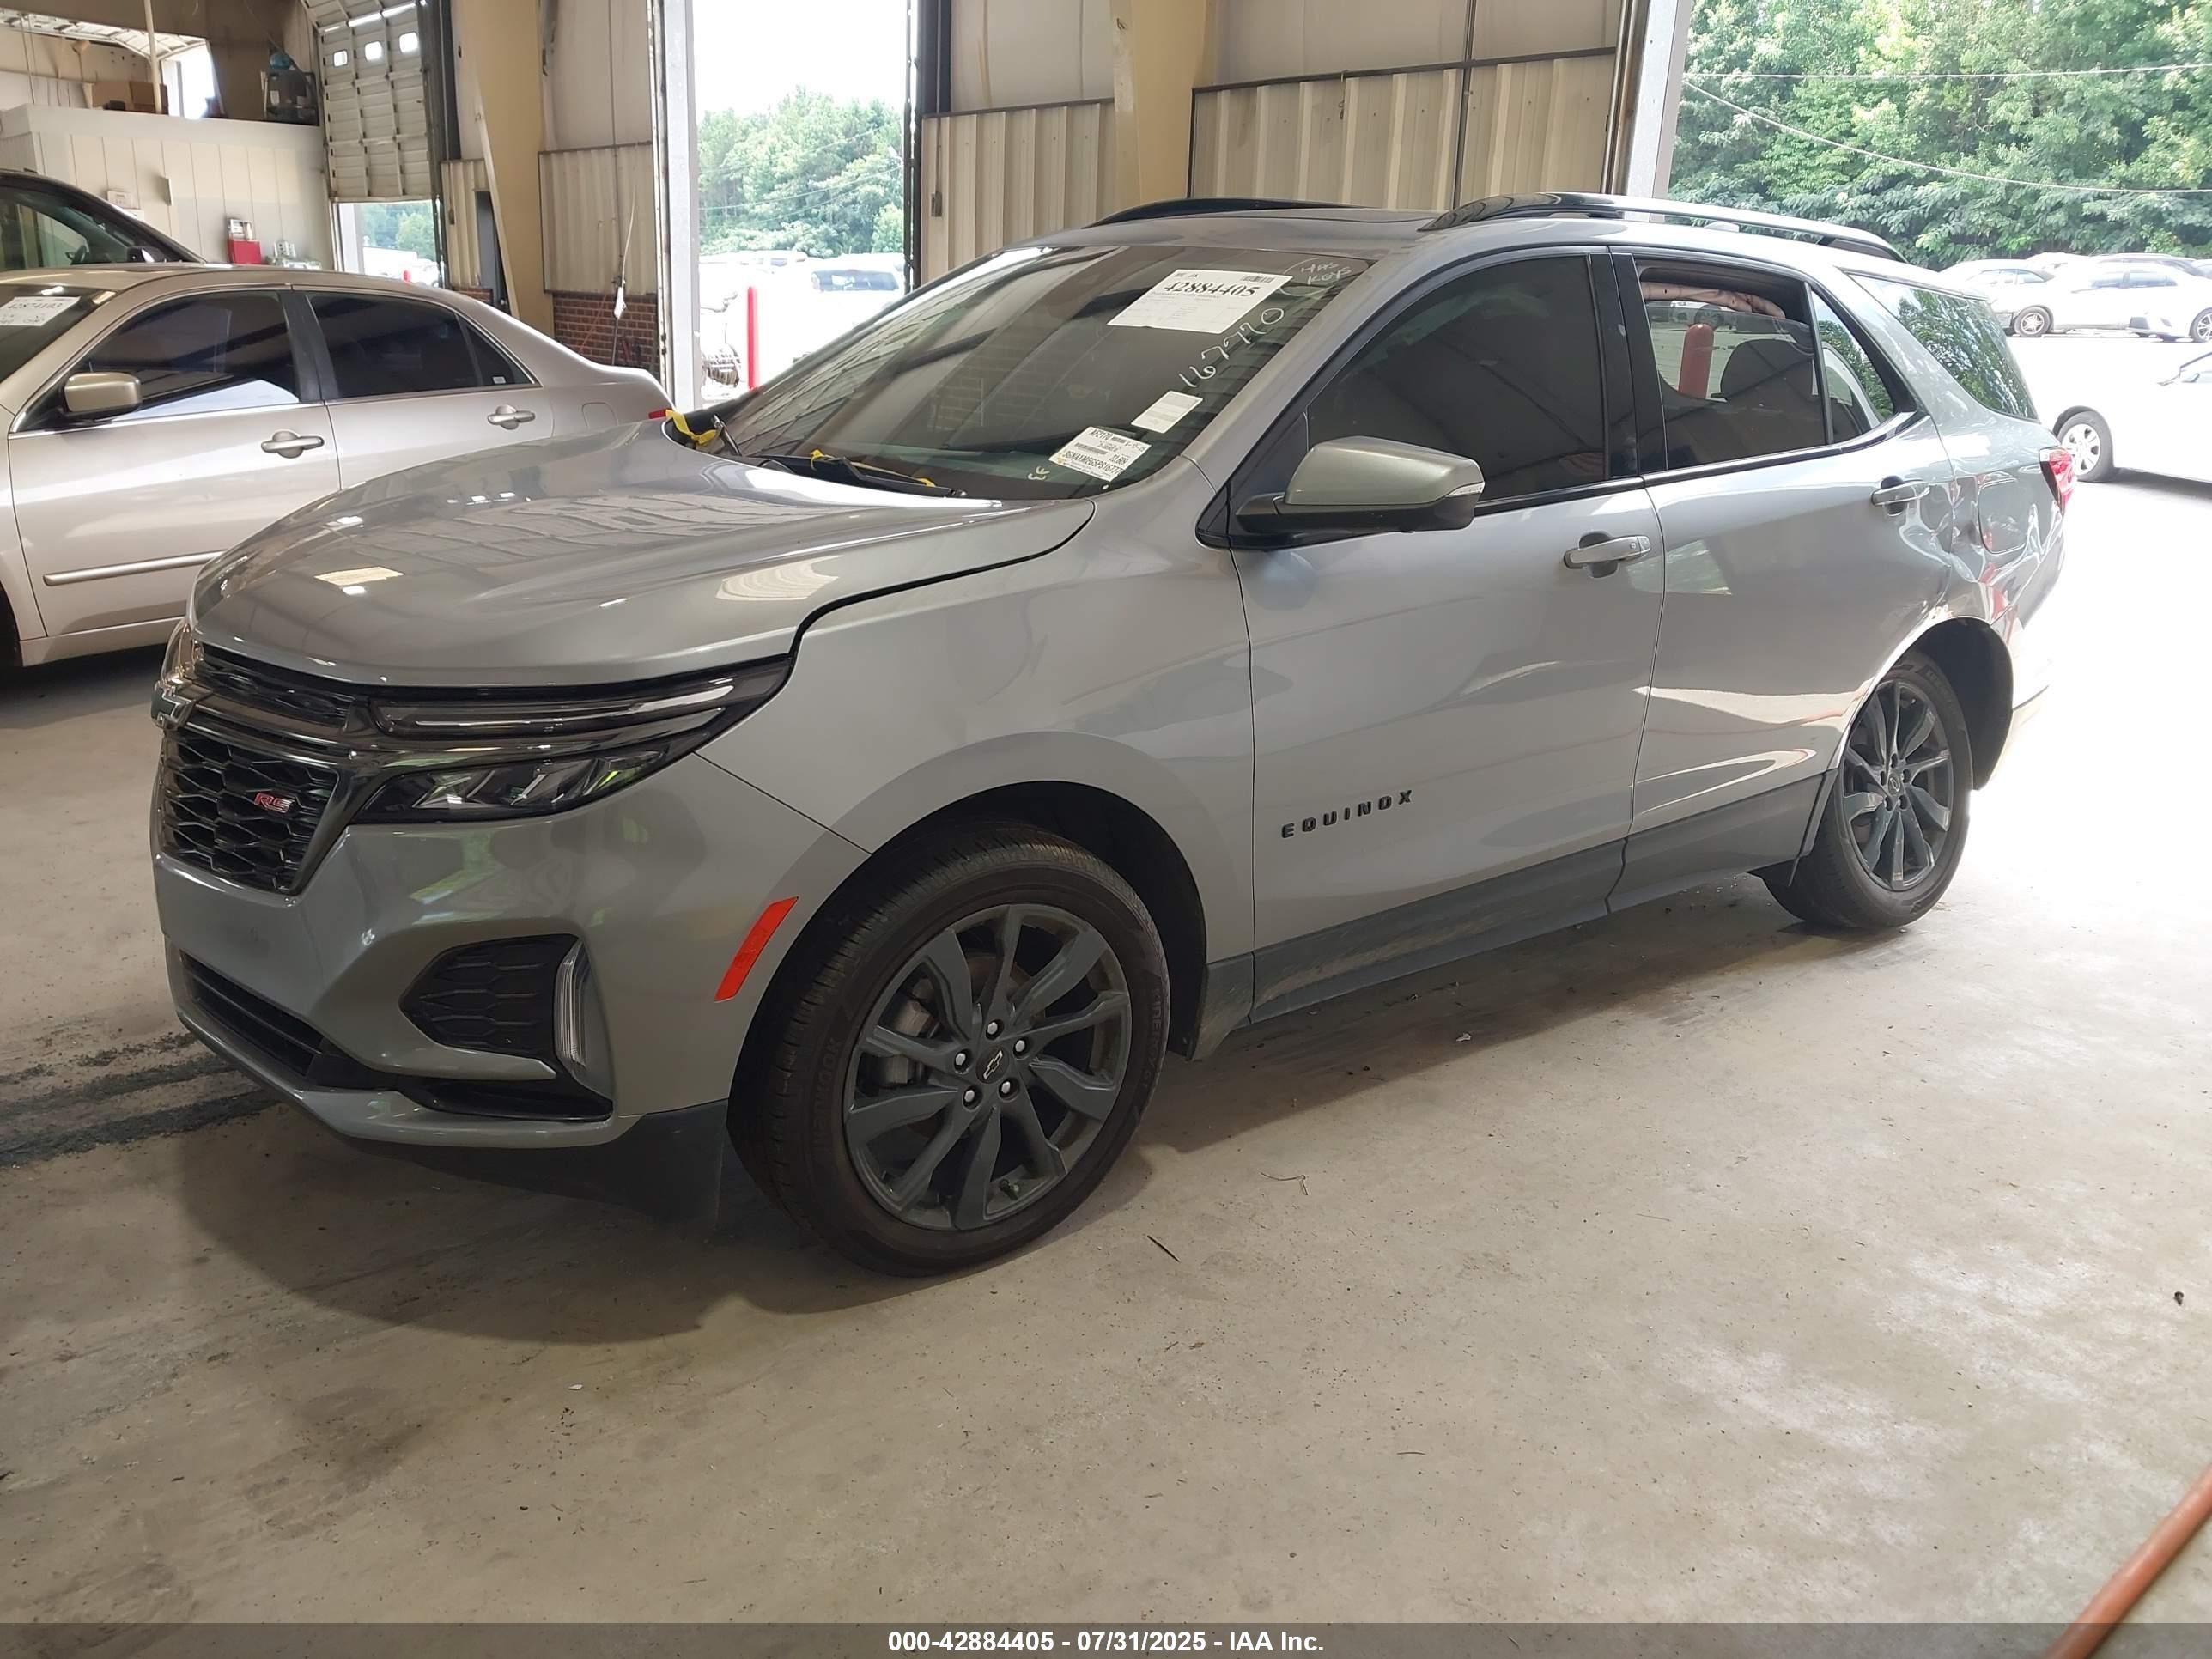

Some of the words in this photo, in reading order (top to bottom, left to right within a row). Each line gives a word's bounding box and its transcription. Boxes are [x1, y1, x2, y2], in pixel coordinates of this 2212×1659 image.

[1300, 262, 1339, 274] HAS
[1307, 266, 1352, 285] KEYS
[1164, 281, 1261, 297] 42884405
[1178, 307, 1285, 388] 167770
[254, 792, 295, 814] RS
[1281, 789, 1413, 839] EQUINOX
